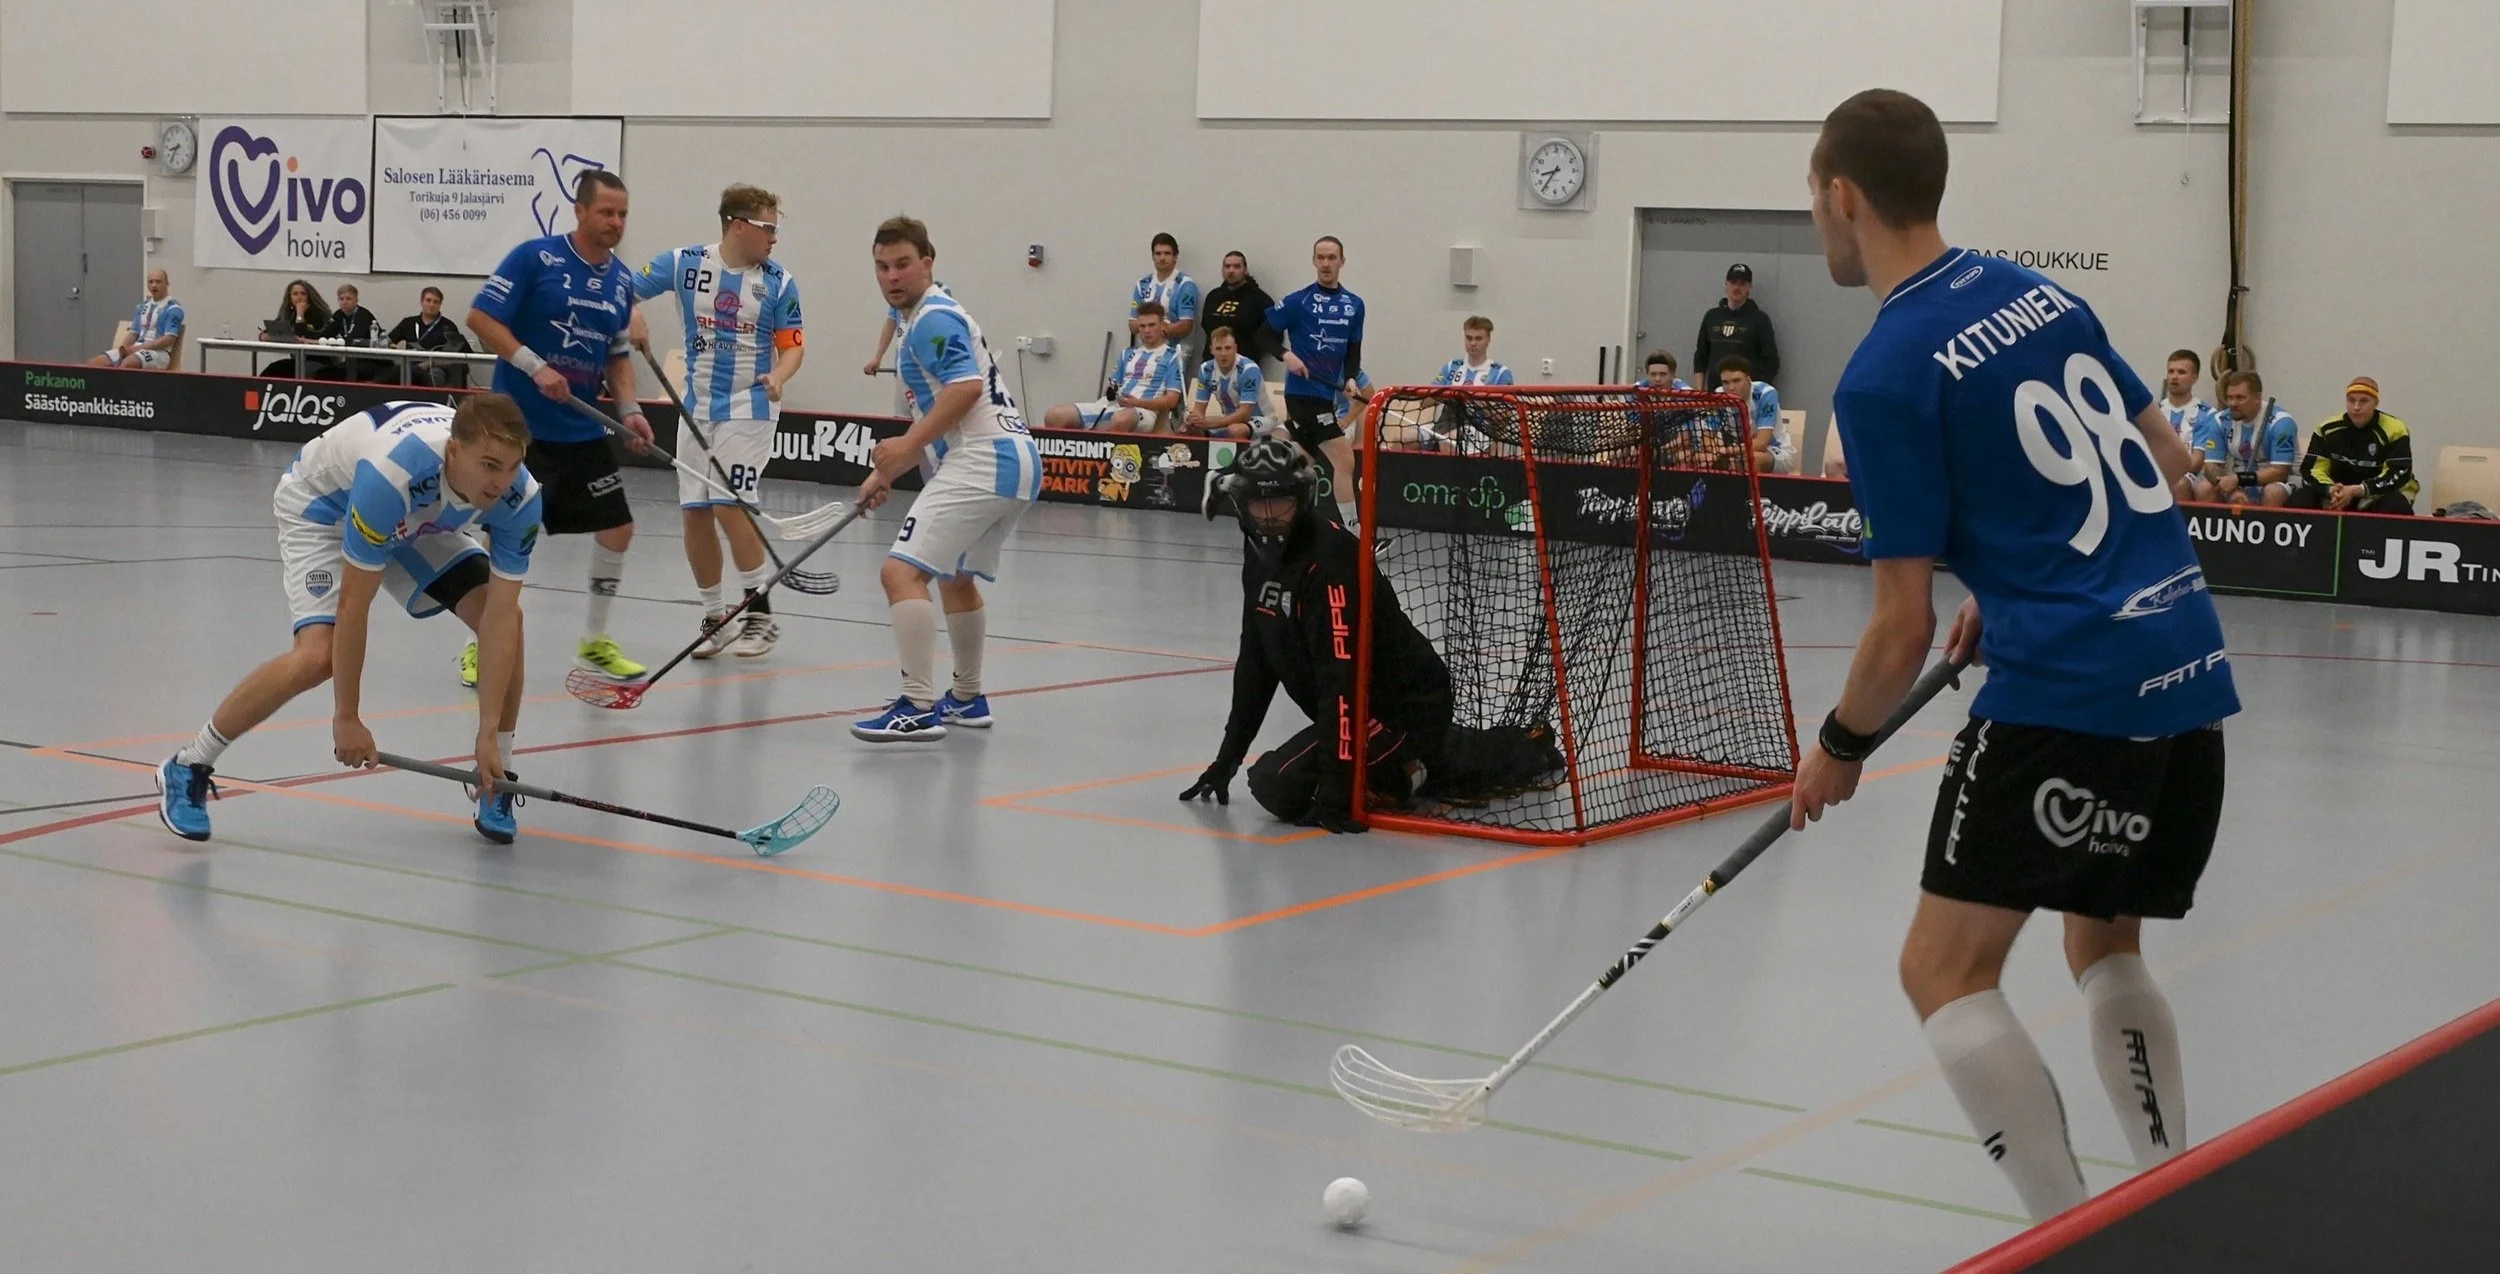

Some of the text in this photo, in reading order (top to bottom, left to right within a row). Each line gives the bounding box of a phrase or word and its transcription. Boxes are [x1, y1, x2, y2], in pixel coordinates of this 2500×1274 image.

[384, 167, 535, 186] Salosen Lääkäriasema
[409, 191, 505, 206] Torikuja 9 Jalasjärvi
[420, 208, 487, 222] (06) 456 0099
[287, 229, 346, 258] hoiva
[1970, 249, 2109, 271] JOUKKUE
[563, 273, 572, 289] 2
[684, 268, 712, 293] 82
[1312, 303, 1323, 313] 24
[793, 330, 802, 346] C
[25, 370, 86, 389] Parkanon
[25, 393, 155, 418] Säästöpankkisäätiö
[2014, 352, 2174, 557] 98
[730, 464, 757, 491] 82
[1042, 475, 1090, 494] PARK
[2274, 522, 2312, 548] OY
[2358, 538, 2462, 584] JR
[1327, 584, 1352, 761] FAT PIPE
[2138, 659, 2201, 697] FAT
